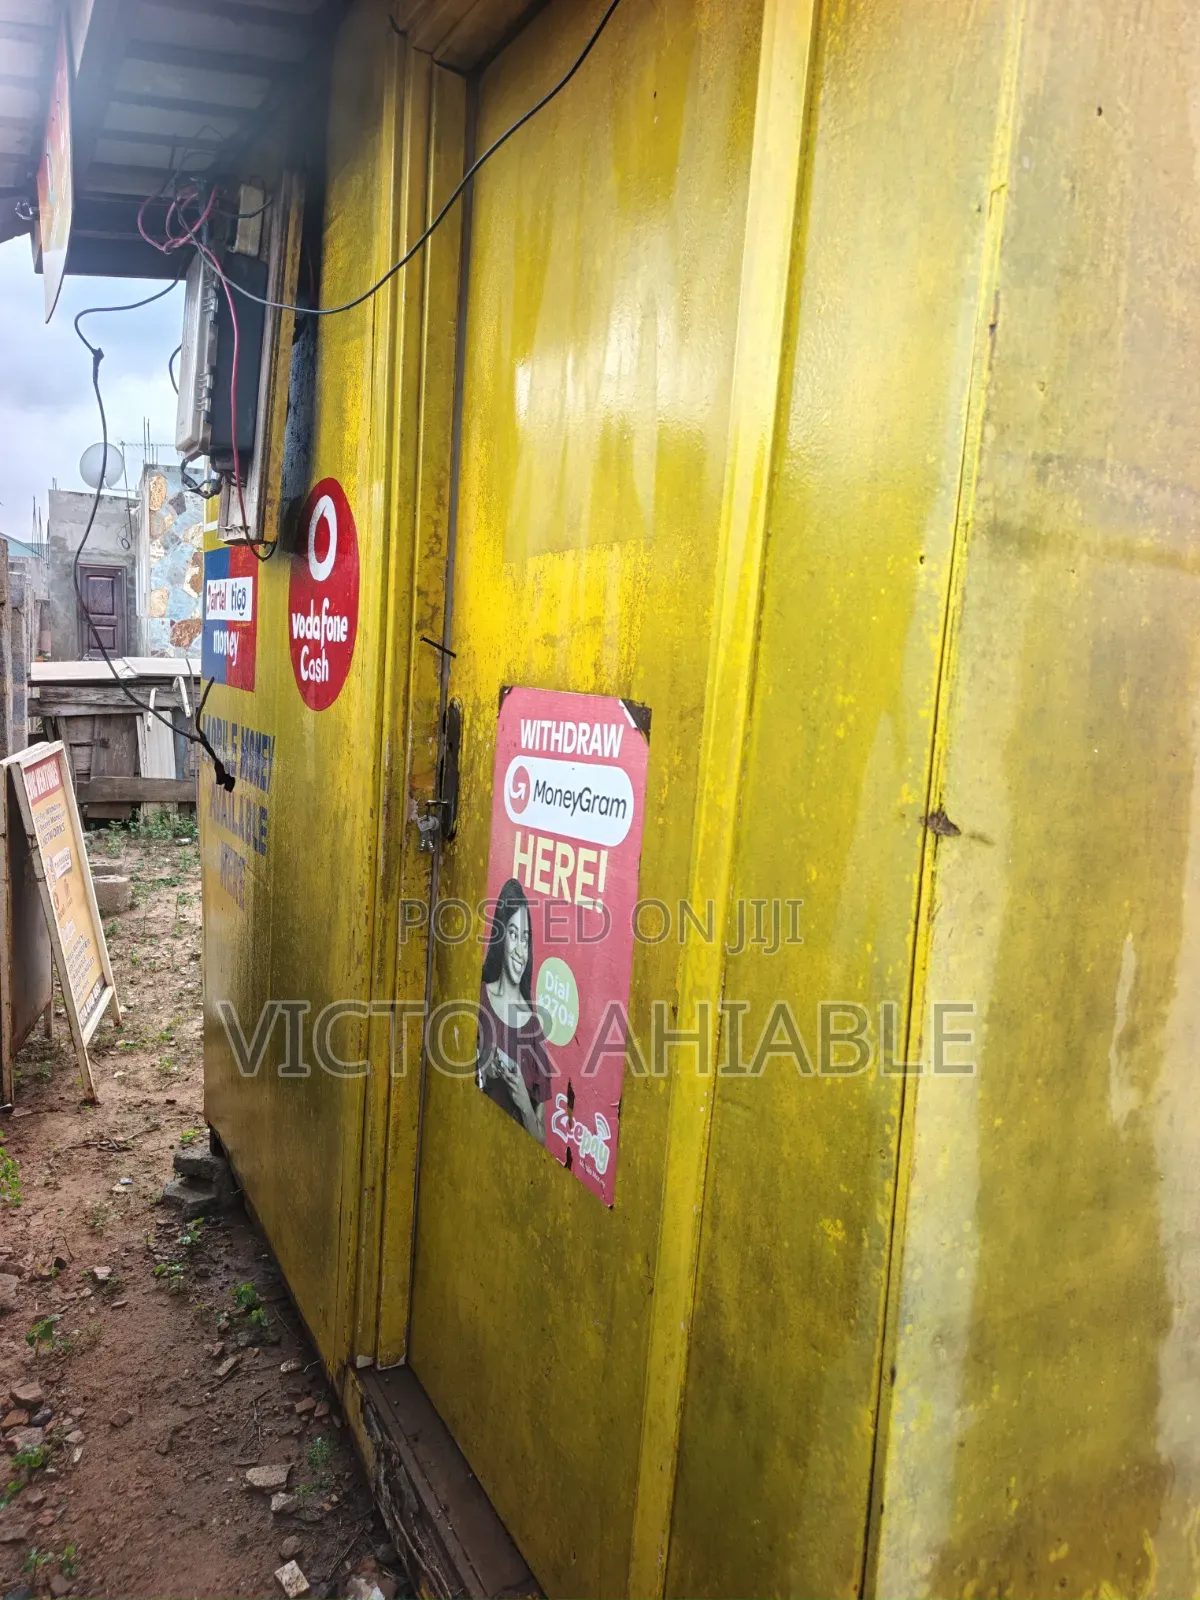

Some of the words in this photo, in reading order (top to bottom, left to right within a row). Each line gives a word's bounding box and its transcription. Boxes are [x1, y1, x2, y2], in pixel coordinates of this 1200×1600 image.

[231, 582, 247, 614] tigo
[292, 598, 348, 646] vodafone
[213, 628, 239, 666] money
[300, 645, 329, 683] Cash
[520, 718, 624, 758] WITHDRAW
[533, 779, 627, 819] MoneyGram
[512, 831, 609, 914] HERE!
[545, 970, 571, 1003] Dial
